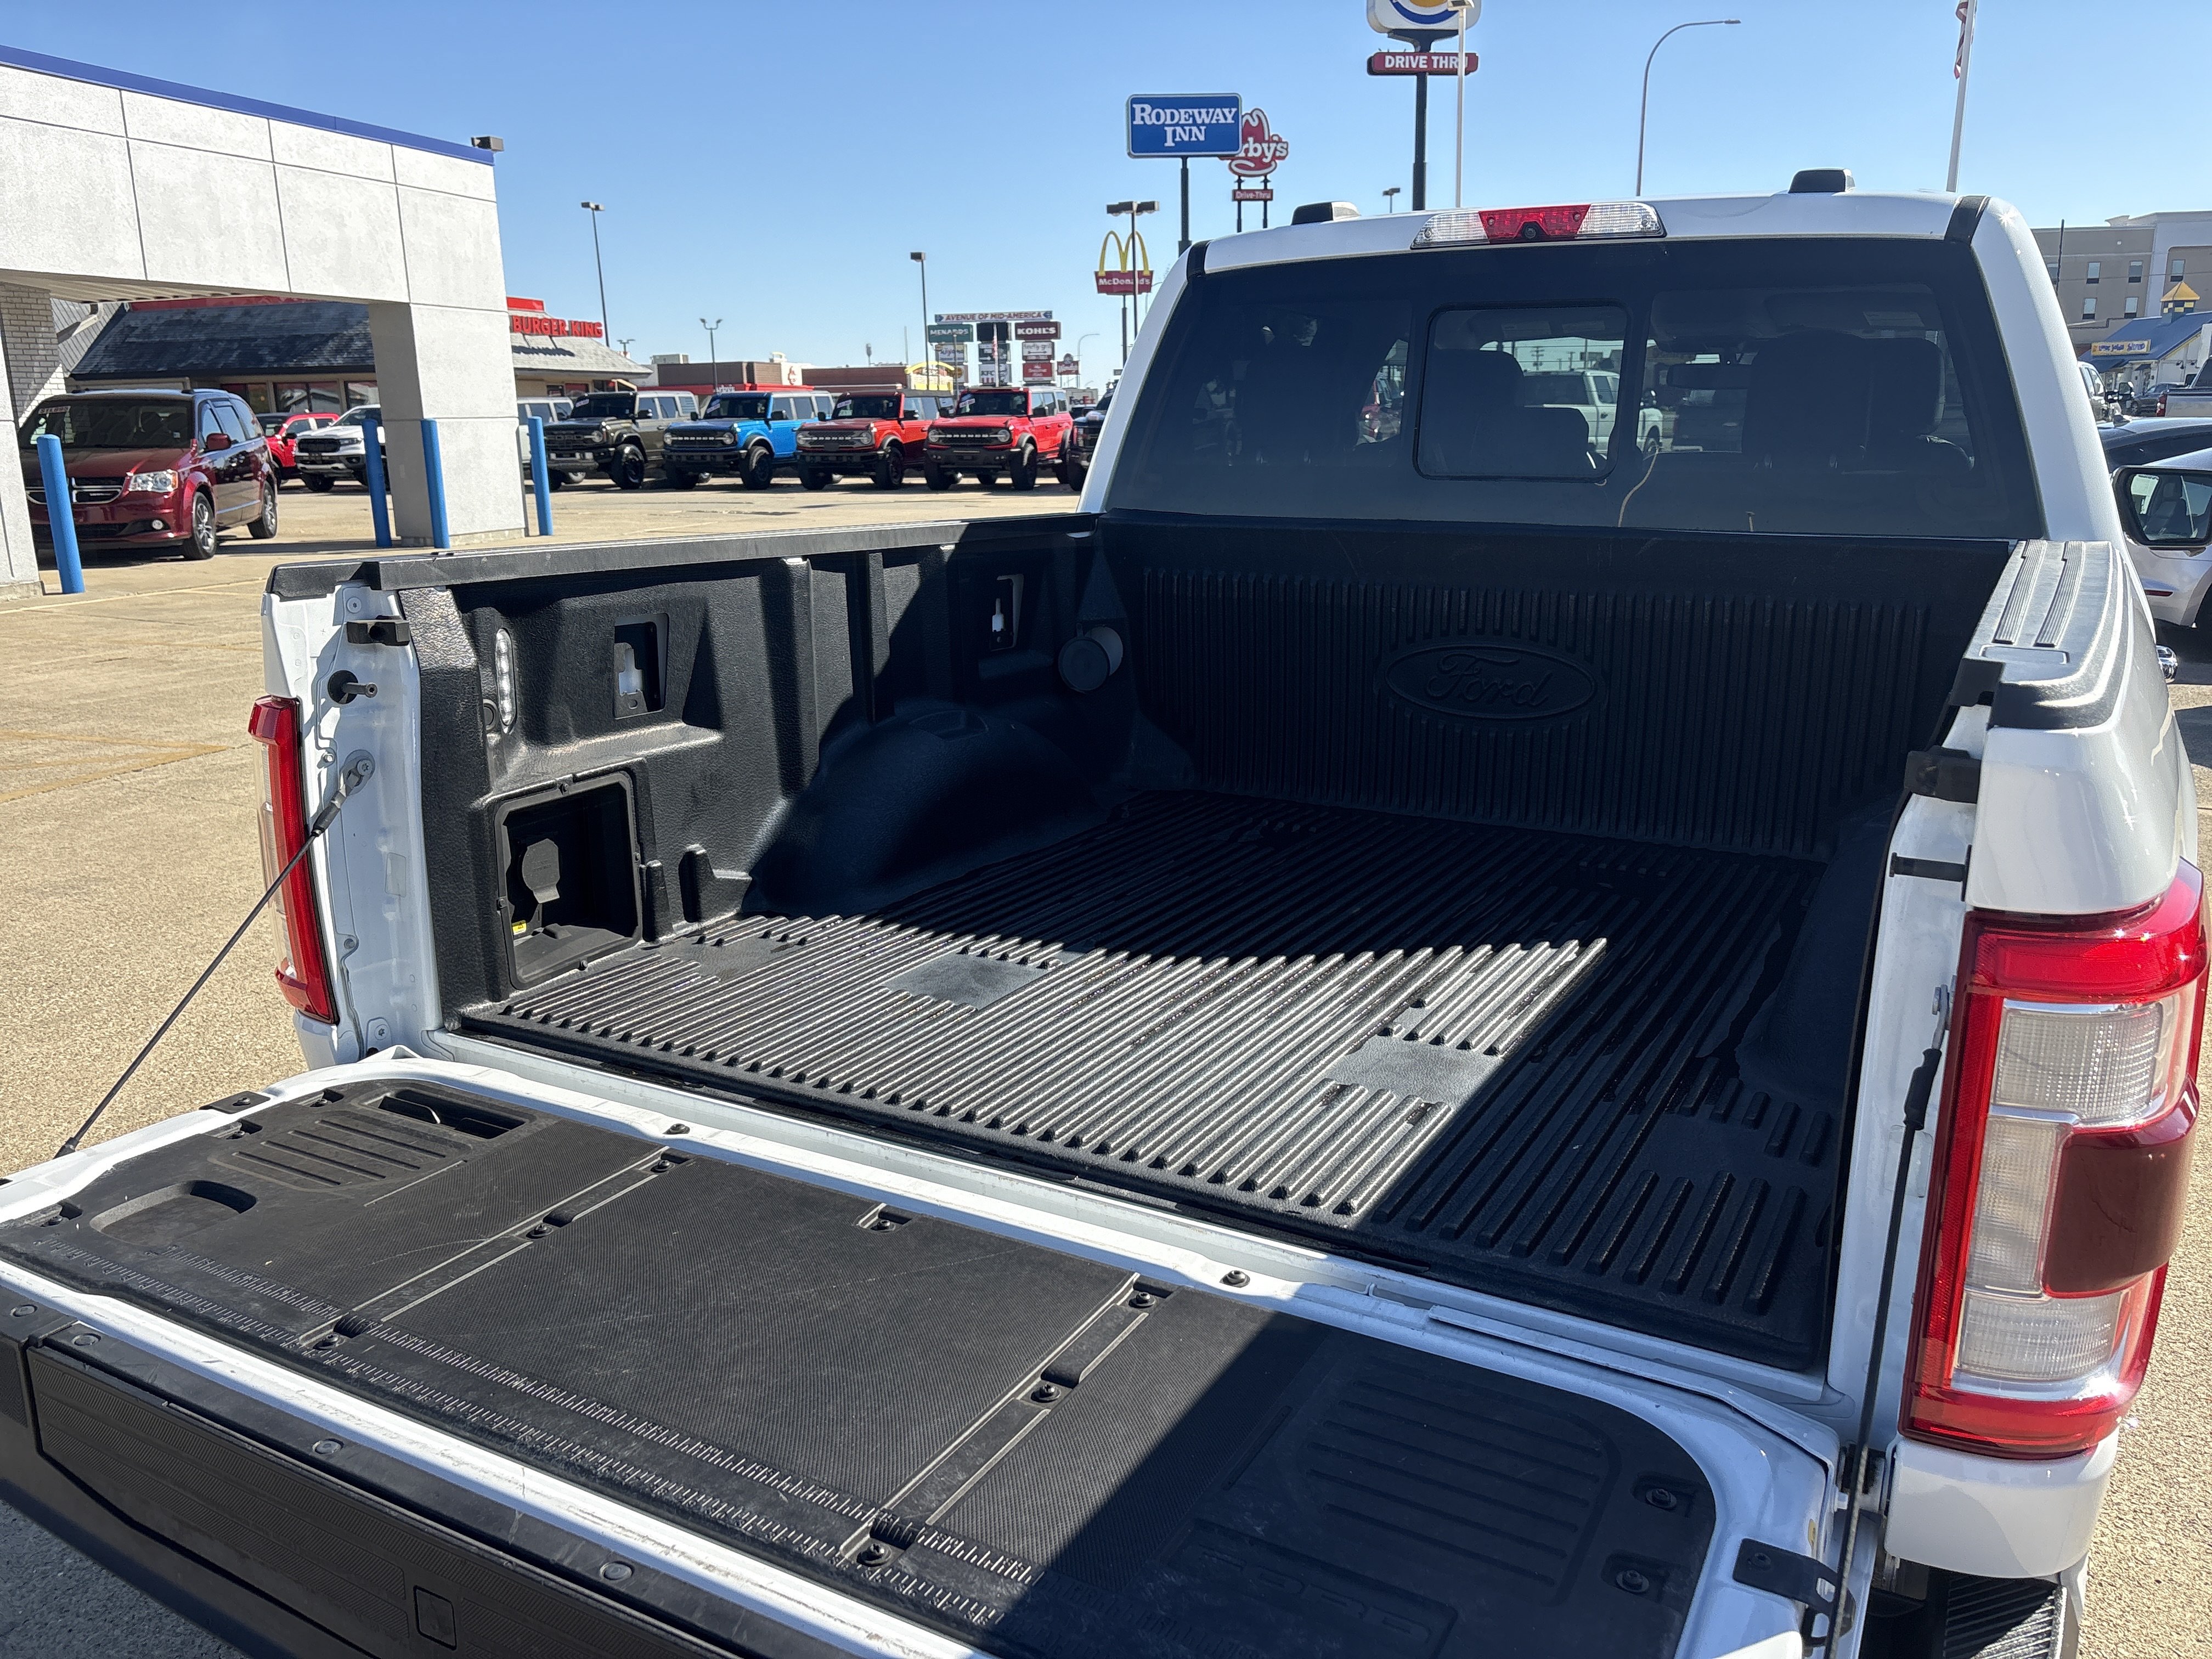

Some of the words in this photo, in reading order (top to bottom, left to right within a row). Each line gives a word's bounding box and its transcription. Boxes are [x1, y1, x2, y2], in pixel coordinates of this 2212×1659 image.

[1385, 55, 1427, 69] DRIVE
[1132, 104, 1238, 125] RODEWAY
[1164, 126, 1206, 146] INN
[1236, 135, 1288, 162] rby's
[512, 315, 568, 336] BURGER
[571, 320, 603, 338] KING
[1069, 396, 1096, 405] FedEx
[1426, 651, 1554, 706] Ford
